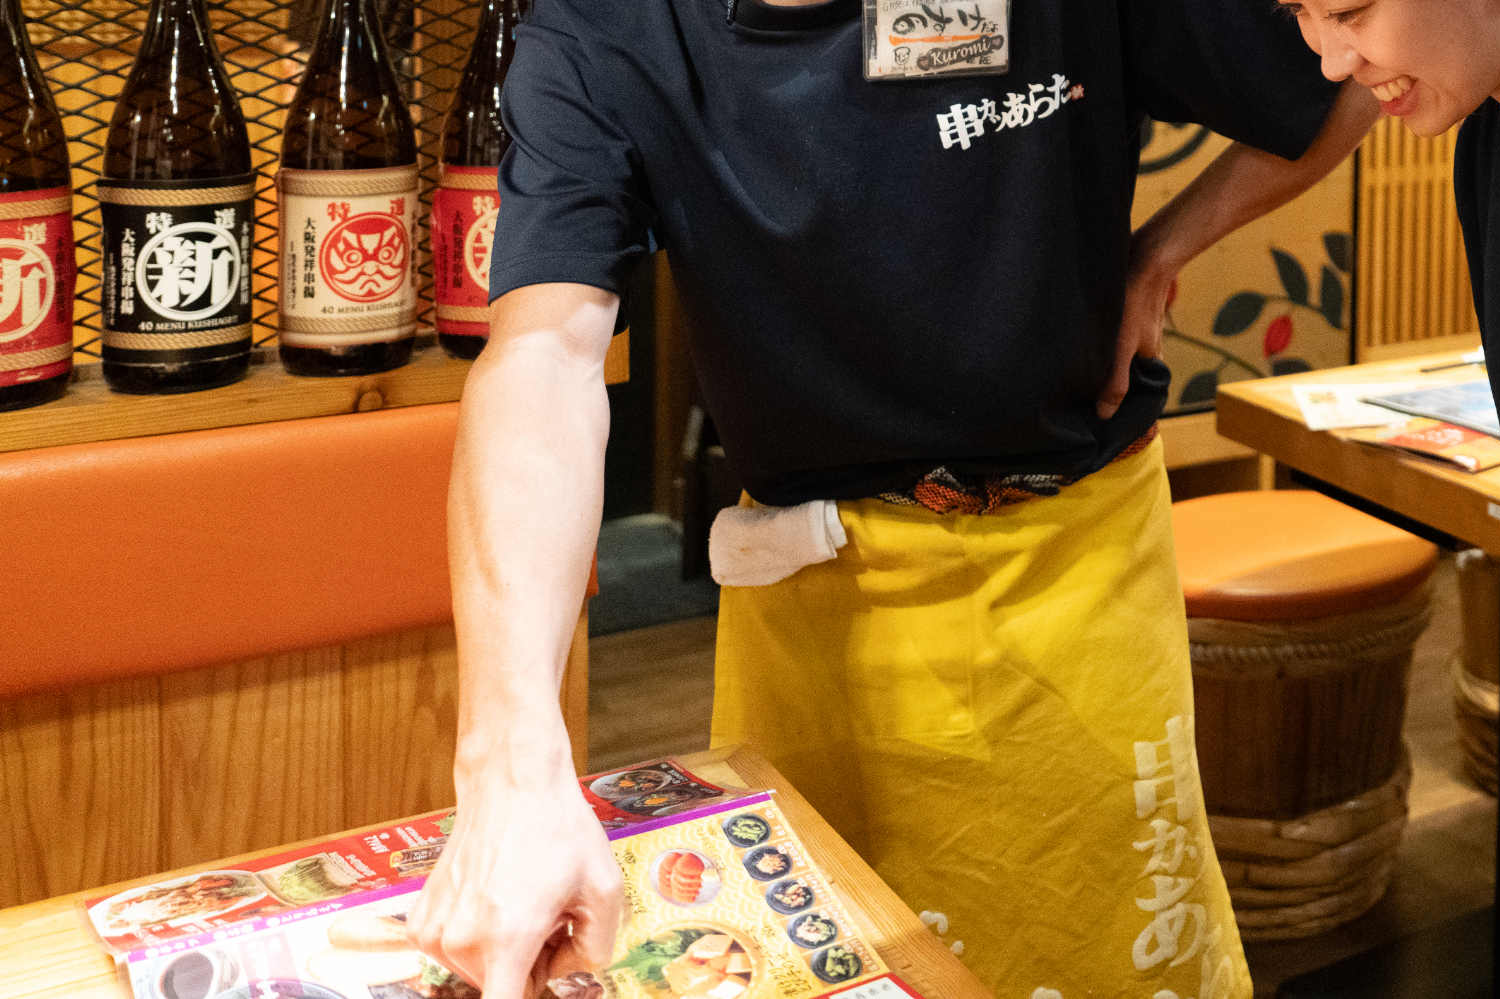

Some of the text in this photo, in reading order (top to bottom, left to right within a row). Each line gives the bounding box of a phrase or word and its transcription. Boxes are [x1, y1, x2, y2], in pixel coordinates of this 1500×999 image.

[931, 38, 992, 65] Kuromi
[936, 72, 1071, 150] 串カツあらた
[147, 236, 235, 309] 新
[138, 321, 154, 331] 40
[155, 320, 186, 331] MENU
